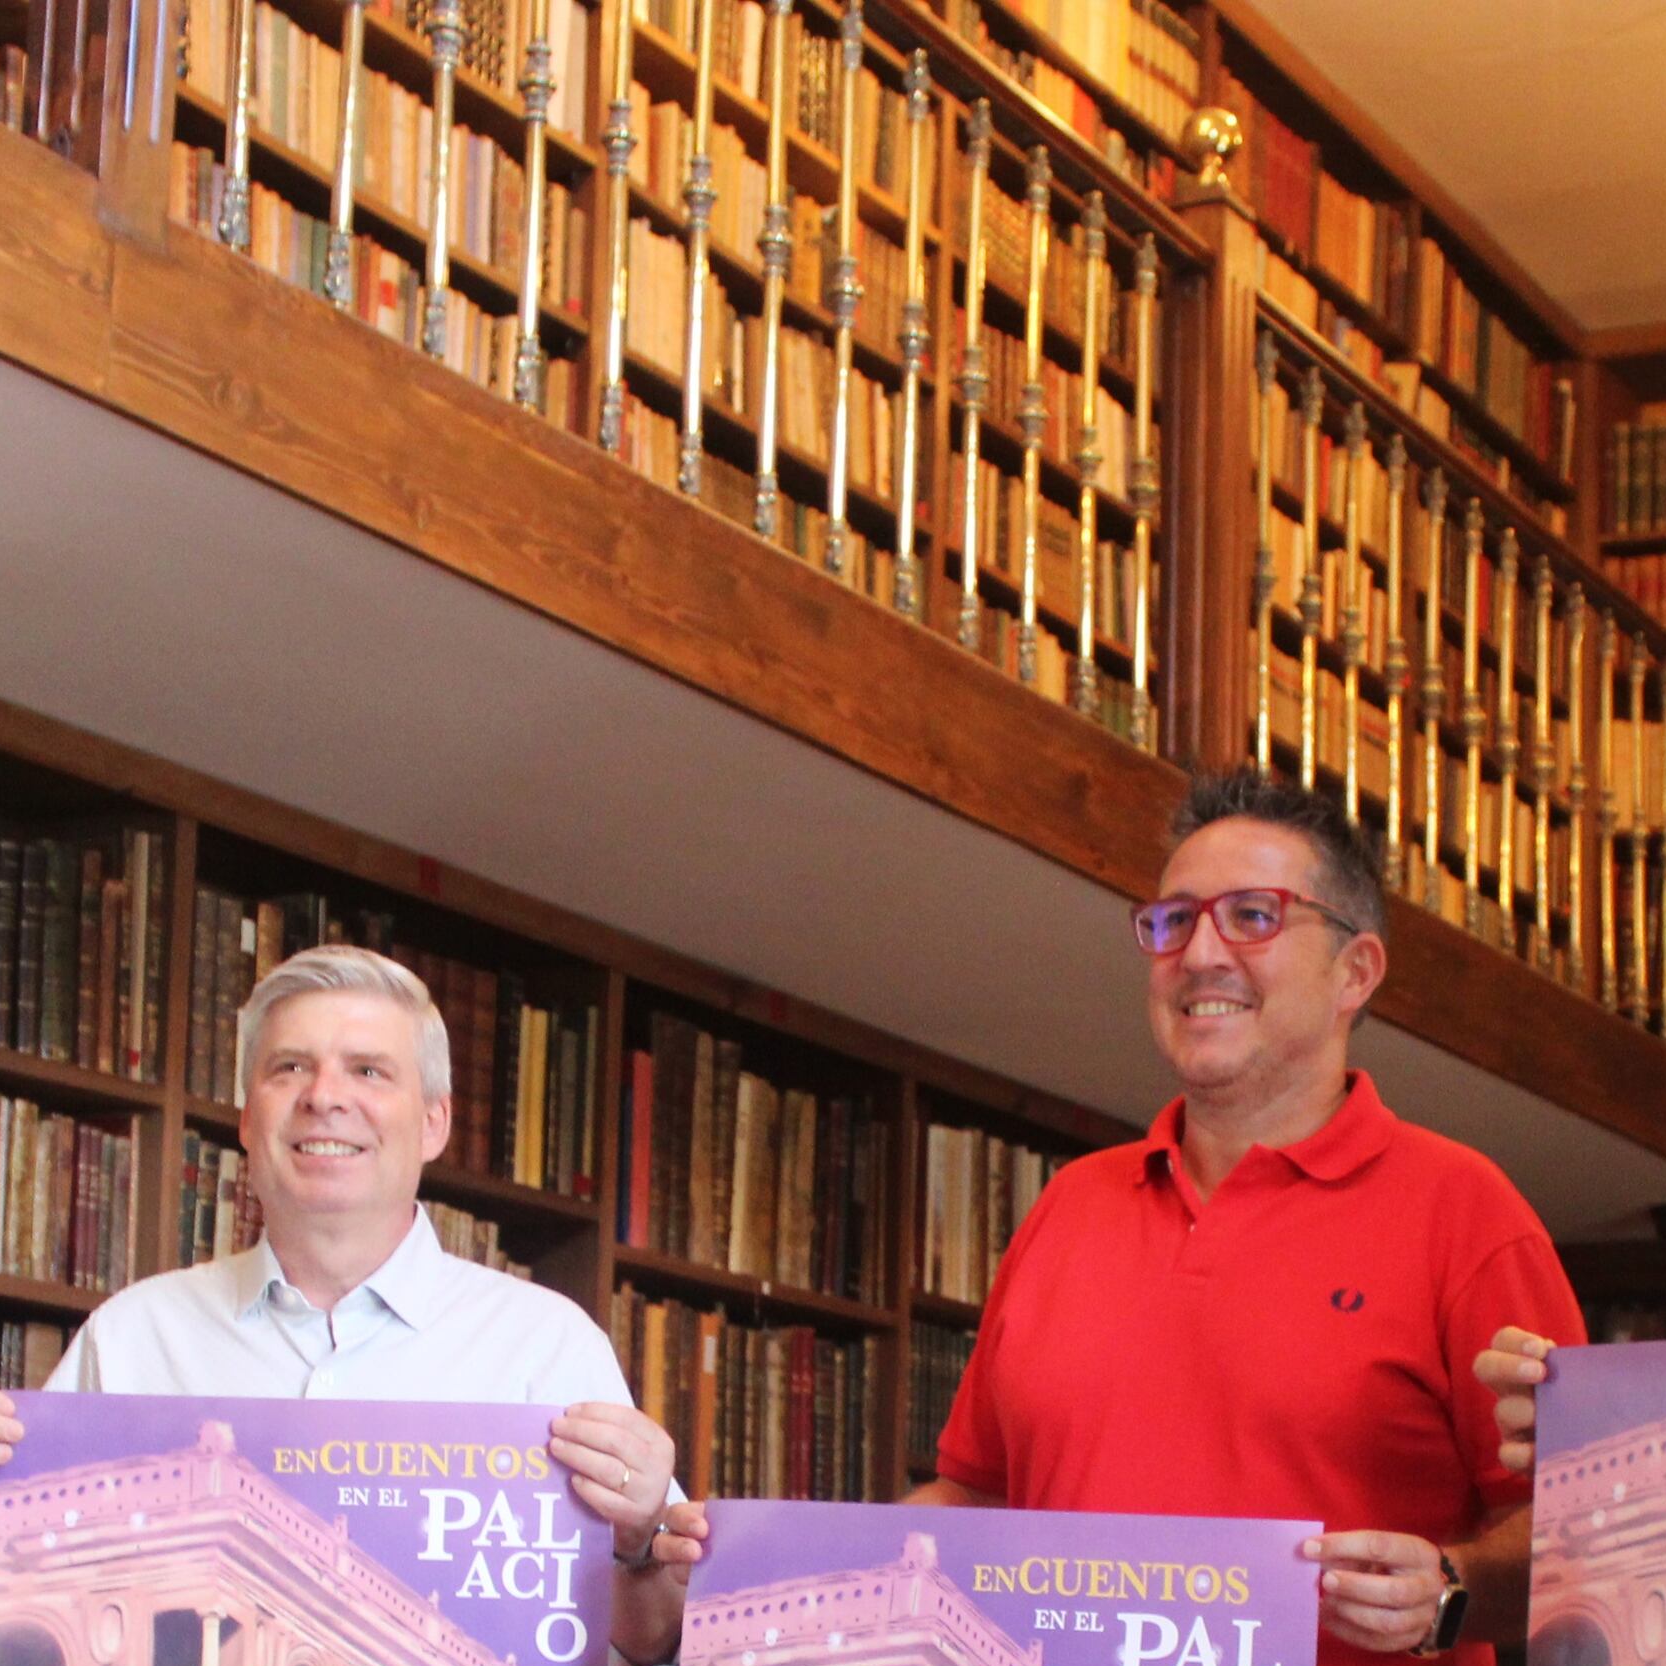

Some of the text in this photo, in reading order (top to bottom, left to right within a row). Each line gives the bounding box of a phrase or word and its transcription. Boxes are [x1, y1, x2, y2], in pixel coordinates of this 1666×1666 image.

[338, 1487, 407, 1507] EN EL
[417, 1488, 581, 1561] PAL
[455, 1551, 579, 1609] ACI
[535, 1612, 588, 1662] O
[1034, 1609, 1104, 1632] EN EL
